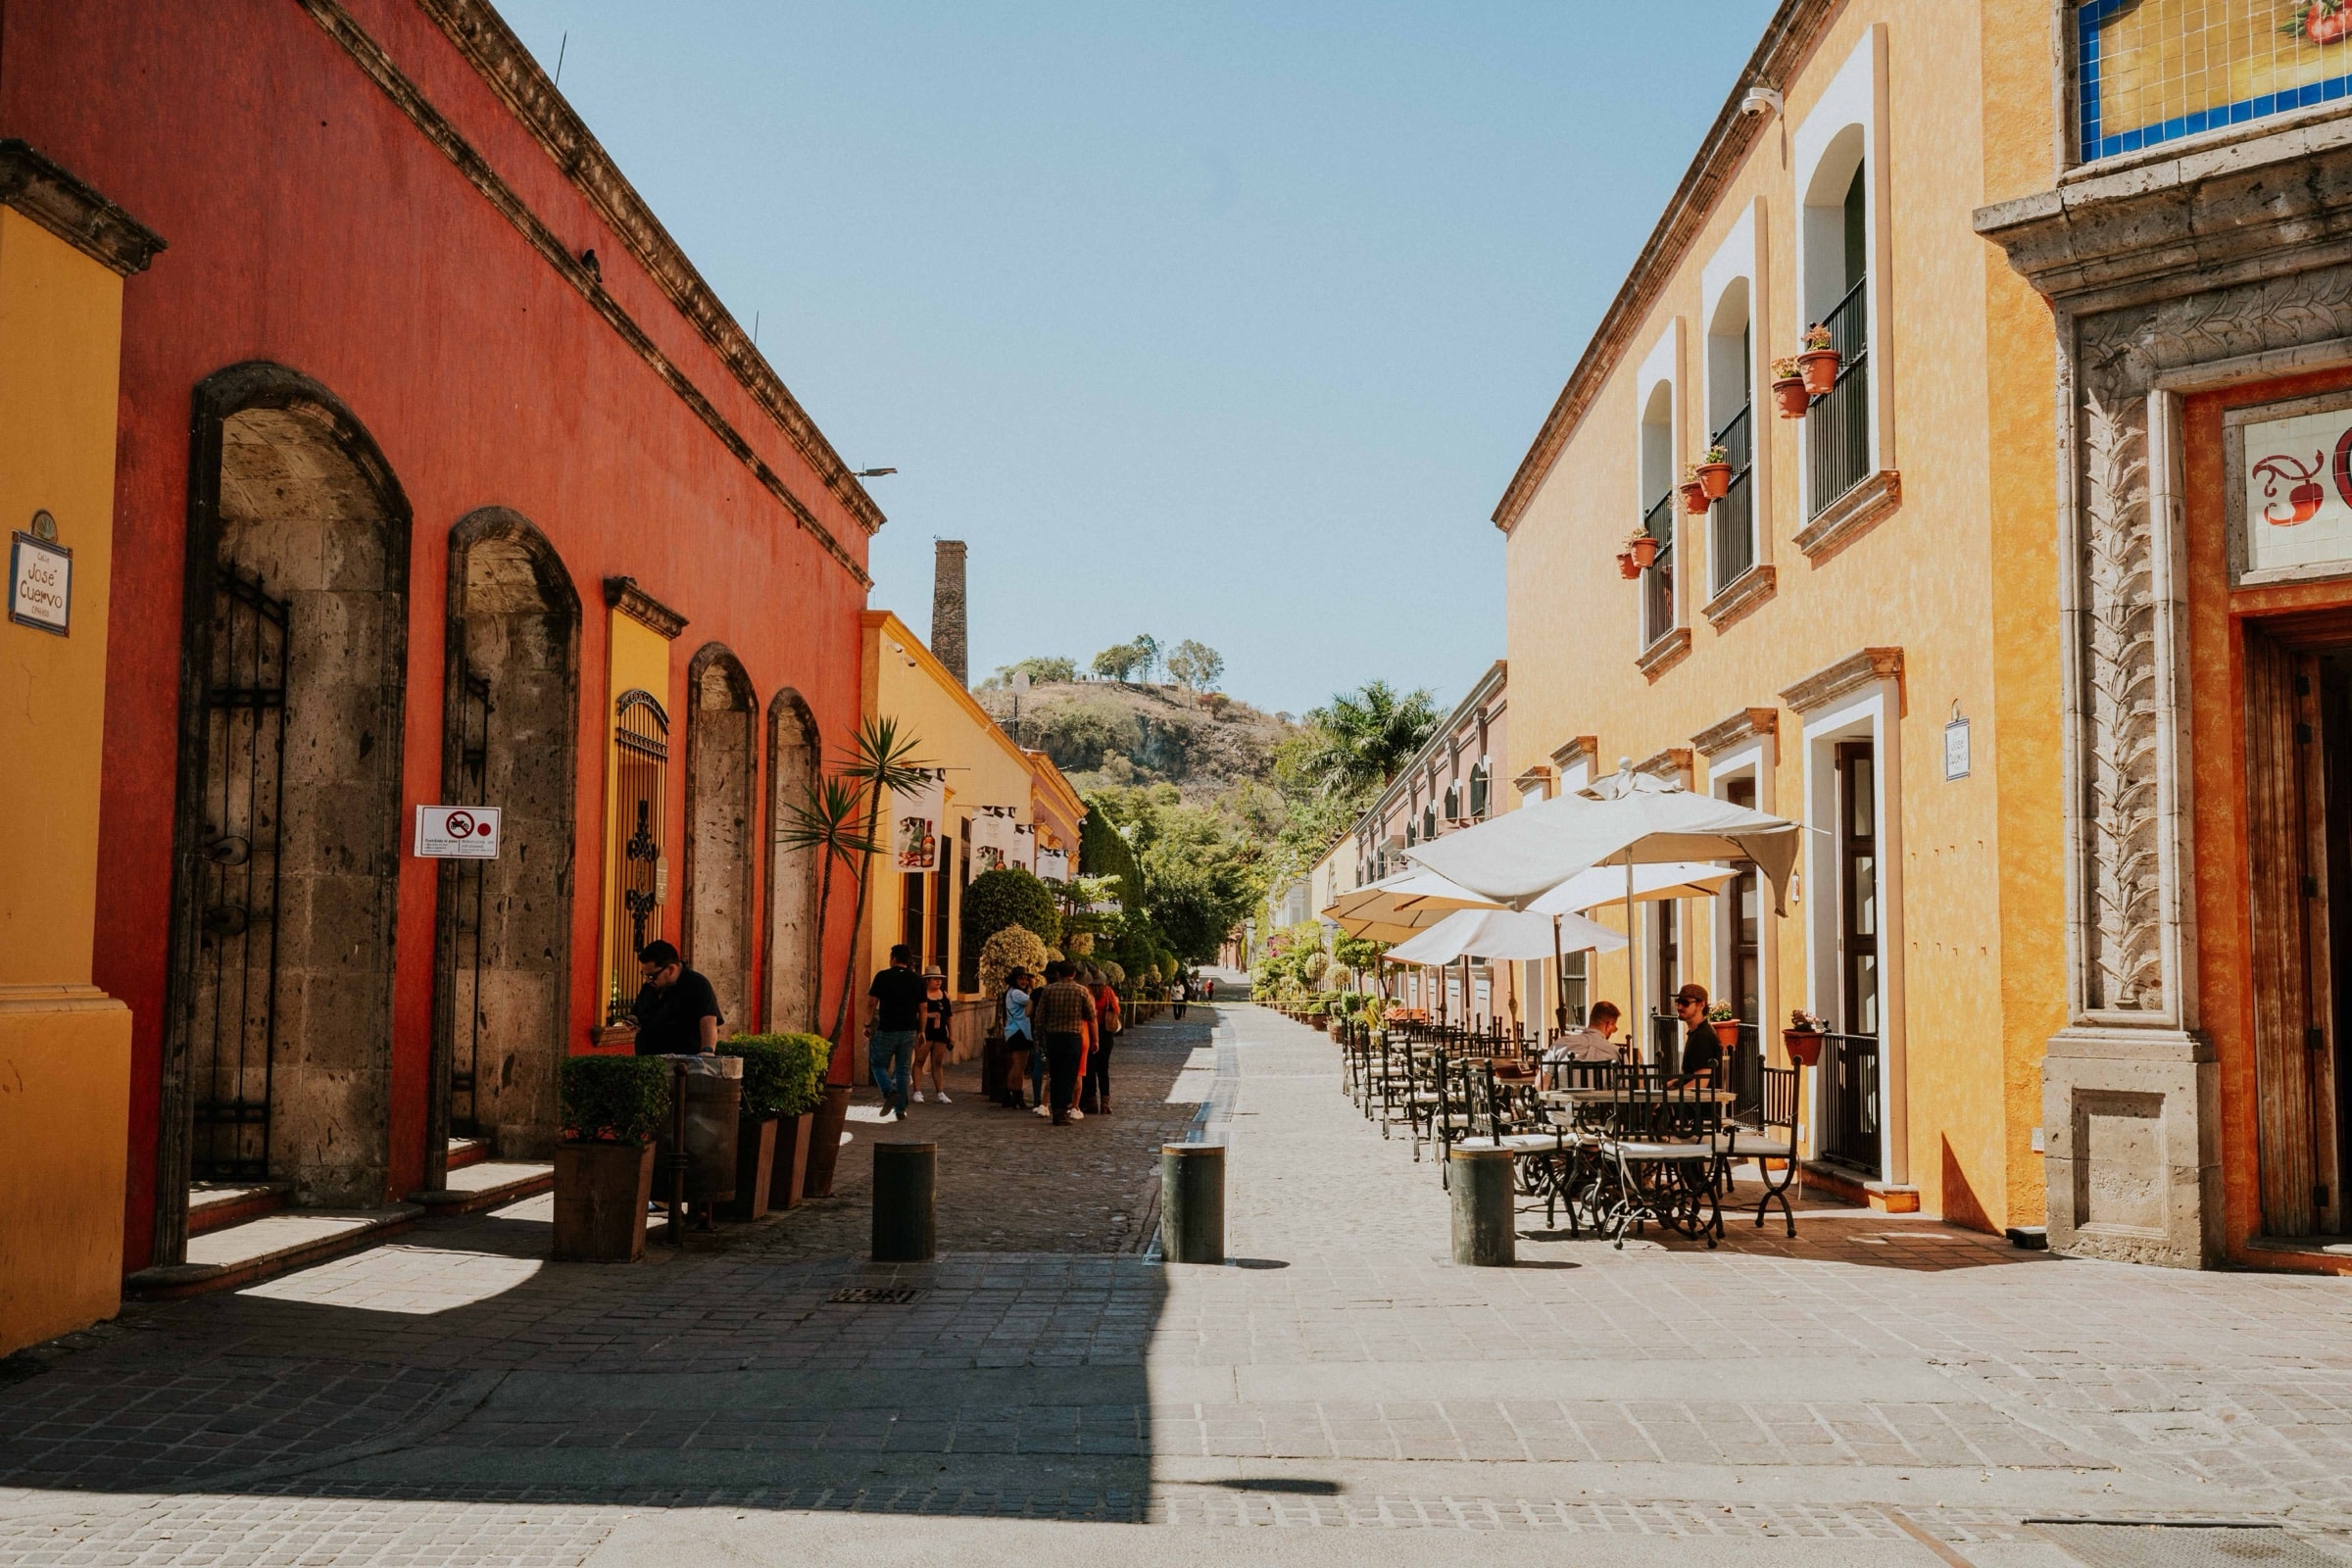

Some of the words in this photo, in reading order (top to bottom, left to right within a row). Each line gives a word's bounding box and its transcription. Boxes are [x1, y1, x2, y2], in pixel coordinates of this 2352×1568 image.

[37, 552, 50, 564] Calle
[28, 564, 58, 586] José
[20, 580, 63, 609] Cuervo
